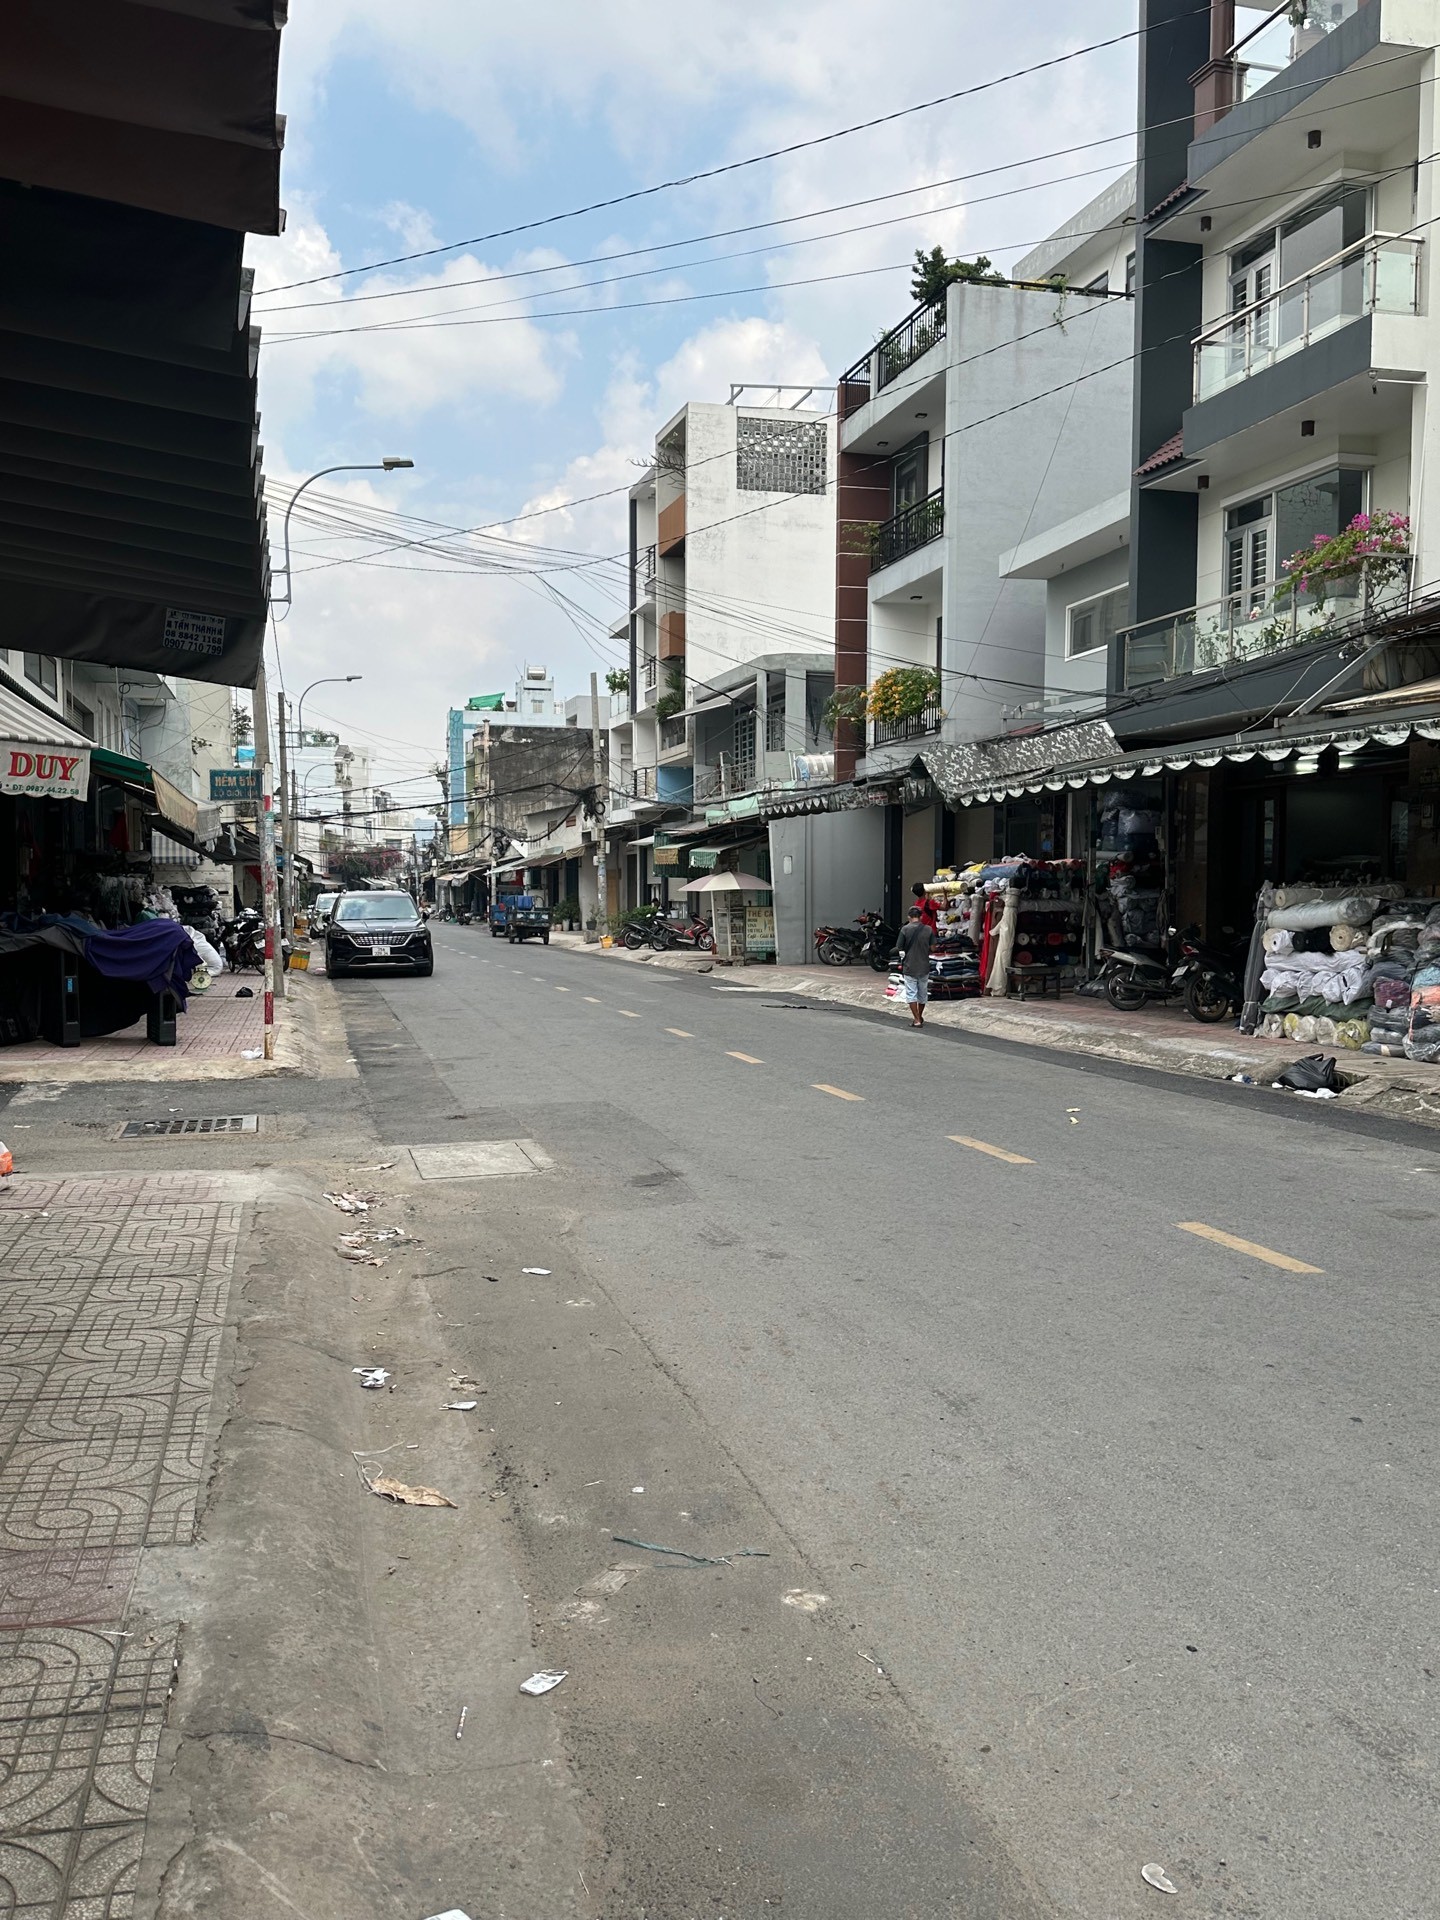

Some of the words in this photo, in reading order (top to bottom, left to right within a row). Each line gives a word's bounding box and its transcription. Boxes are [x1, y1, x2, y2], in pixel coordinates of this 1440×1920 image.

[164, 637, 185, 649] 0907
[188, 641, 204, 652] 710
[206, 644, 222, 655] 799
[165, 629, 176, 637] 08
[178, 631, 199, 642] 8842
[202, 635, 222, 645] 1168
[8, 751, 82, 781] DUY
